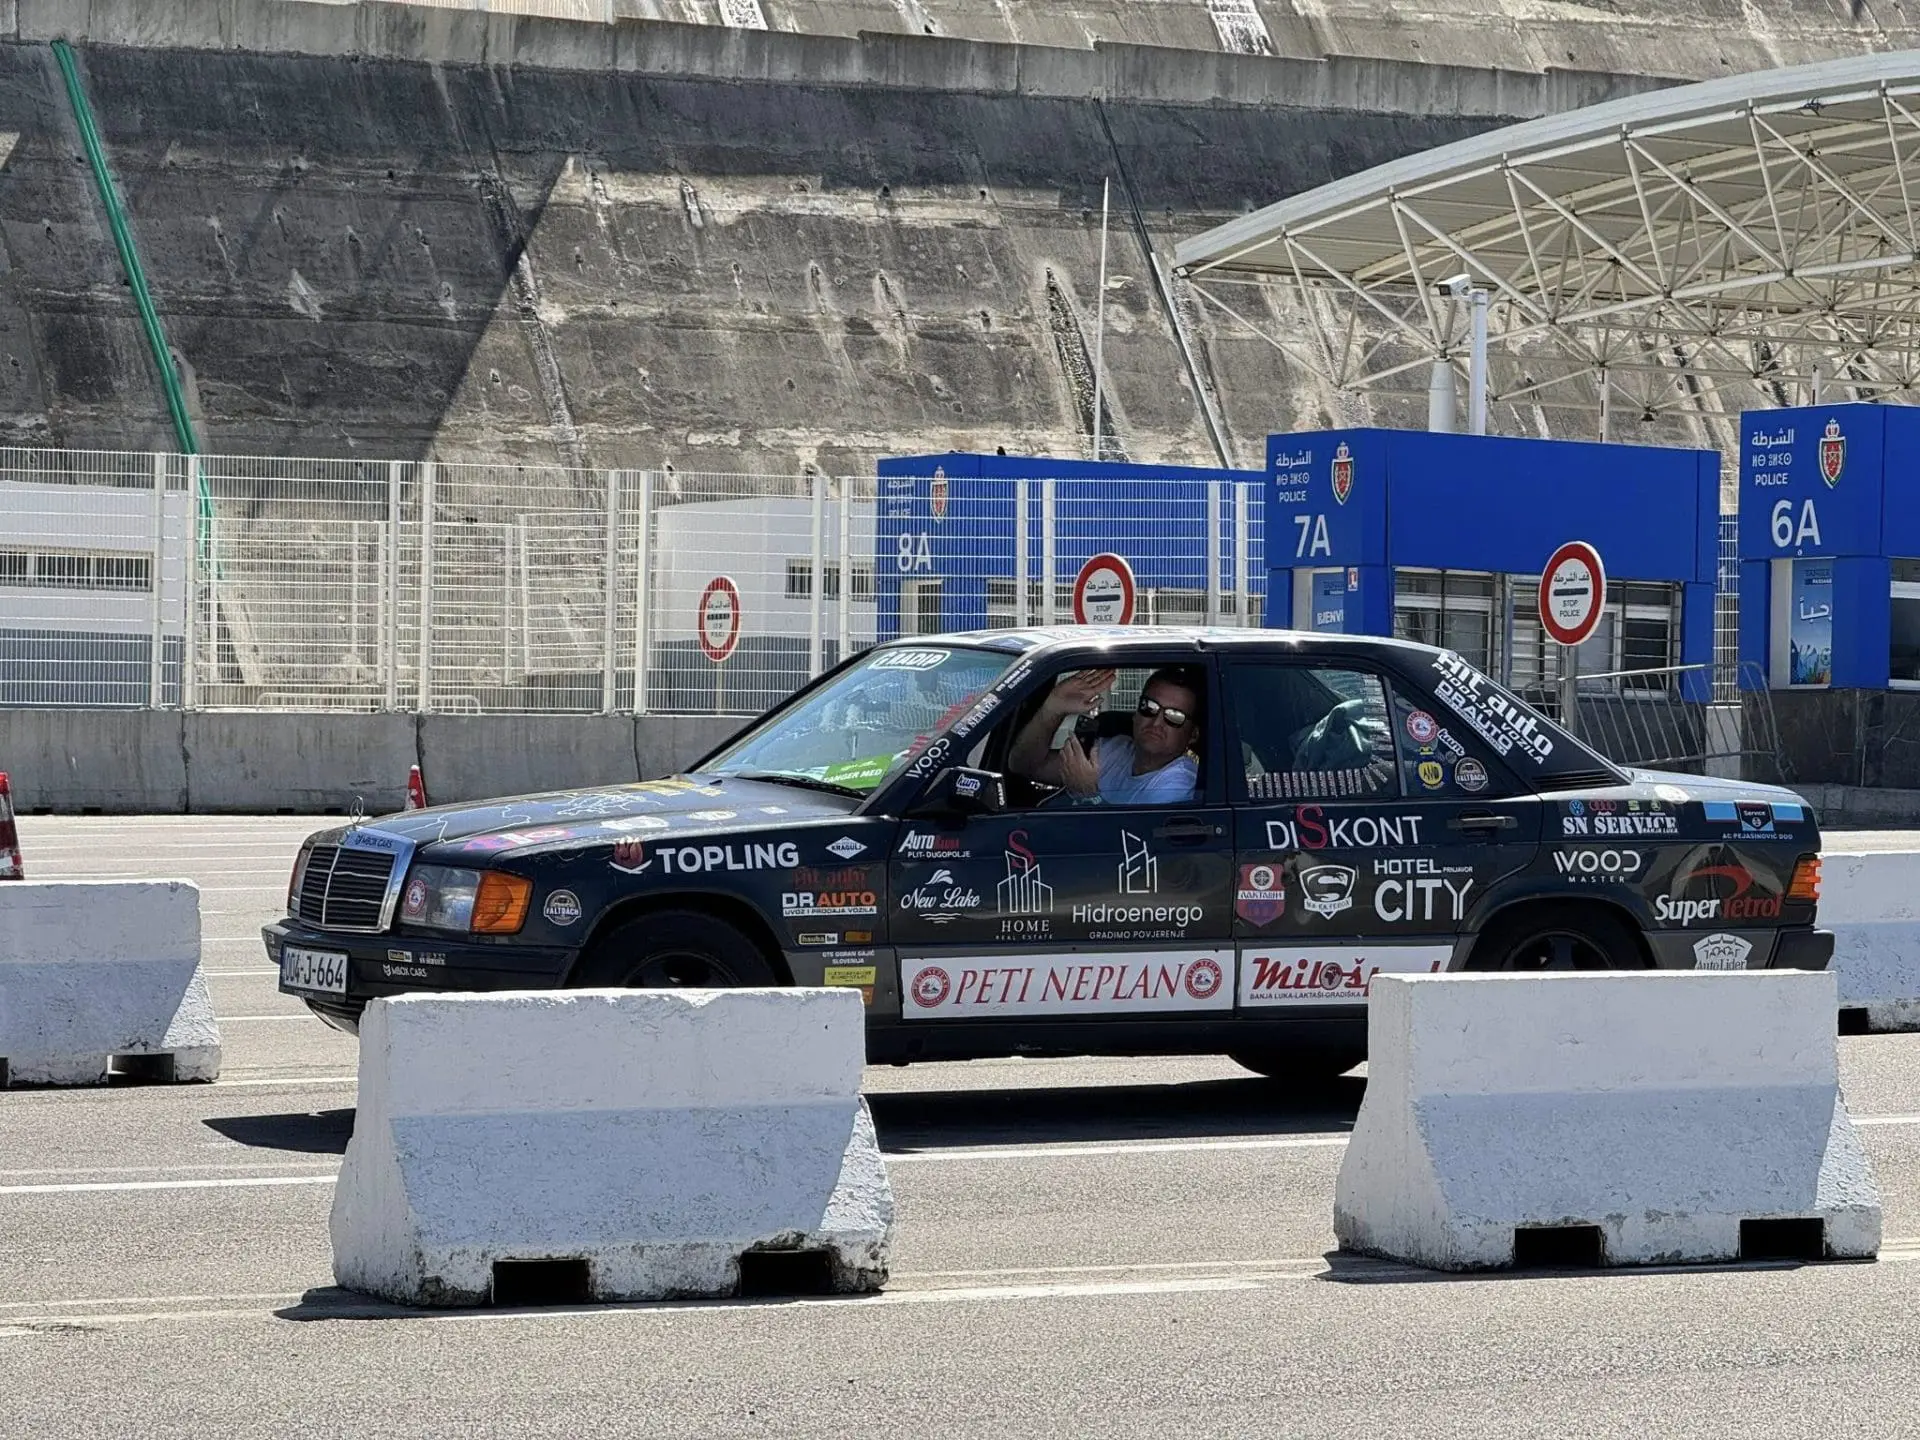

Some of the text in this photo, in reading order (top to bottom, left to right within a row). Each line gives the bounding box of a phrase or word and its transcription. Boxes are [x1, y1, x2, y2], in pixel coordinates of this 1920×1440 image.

[1752, 428, 1794, 449] الشرطة
[1276, 450, 1312, 468] الشرطة
[1755, 472, 1789, 486] POLICE
[1279, 490, 1307, 503] POLICE
[1771, 499, 1821, 548] 6A
[1294, 514, 1331, 558] 7A
[898, 532, 931, 572] 8A
[1560, 609, 1580, 617] POLICE
[1563, 600, 1578, 608] STOP
[1093, 614, 1113, 622] POLICE
[1432, 662, 1544, 764] PRODAJA VOZILA
[1488, 694, 1554, 756] auto
[860, 768, 883, 778] MED
[1265, 803, 1423, 850] DISKONT
[1563, 816, 1677, 834] SN SERVICE
[655, 842, 800, 874] TOPLING
[1374, 859, 1442, 875] HOTEL
[1552, 850, 1641, 873] WOOD
[782, 892, 876, 908] DR AUTO
[900, 887, 981, 909] New Lake
[1374, 878, 1474, 922] CITY
[1072, 904, 1204, 928] Hidroenergo
[1655, 894, 1720, 927] Super
[1001, 920, 1050, 933] HOME
[1089, 929, 1186, 939] GRADIMO POVJERENJE
[410, 968, 427, 977] CARS
[952, 967, 1035, 1005] PETI
[1040, 963, 1185, 1002] NEPLAN
[1250, 992, 1273, 1000] BANJA
